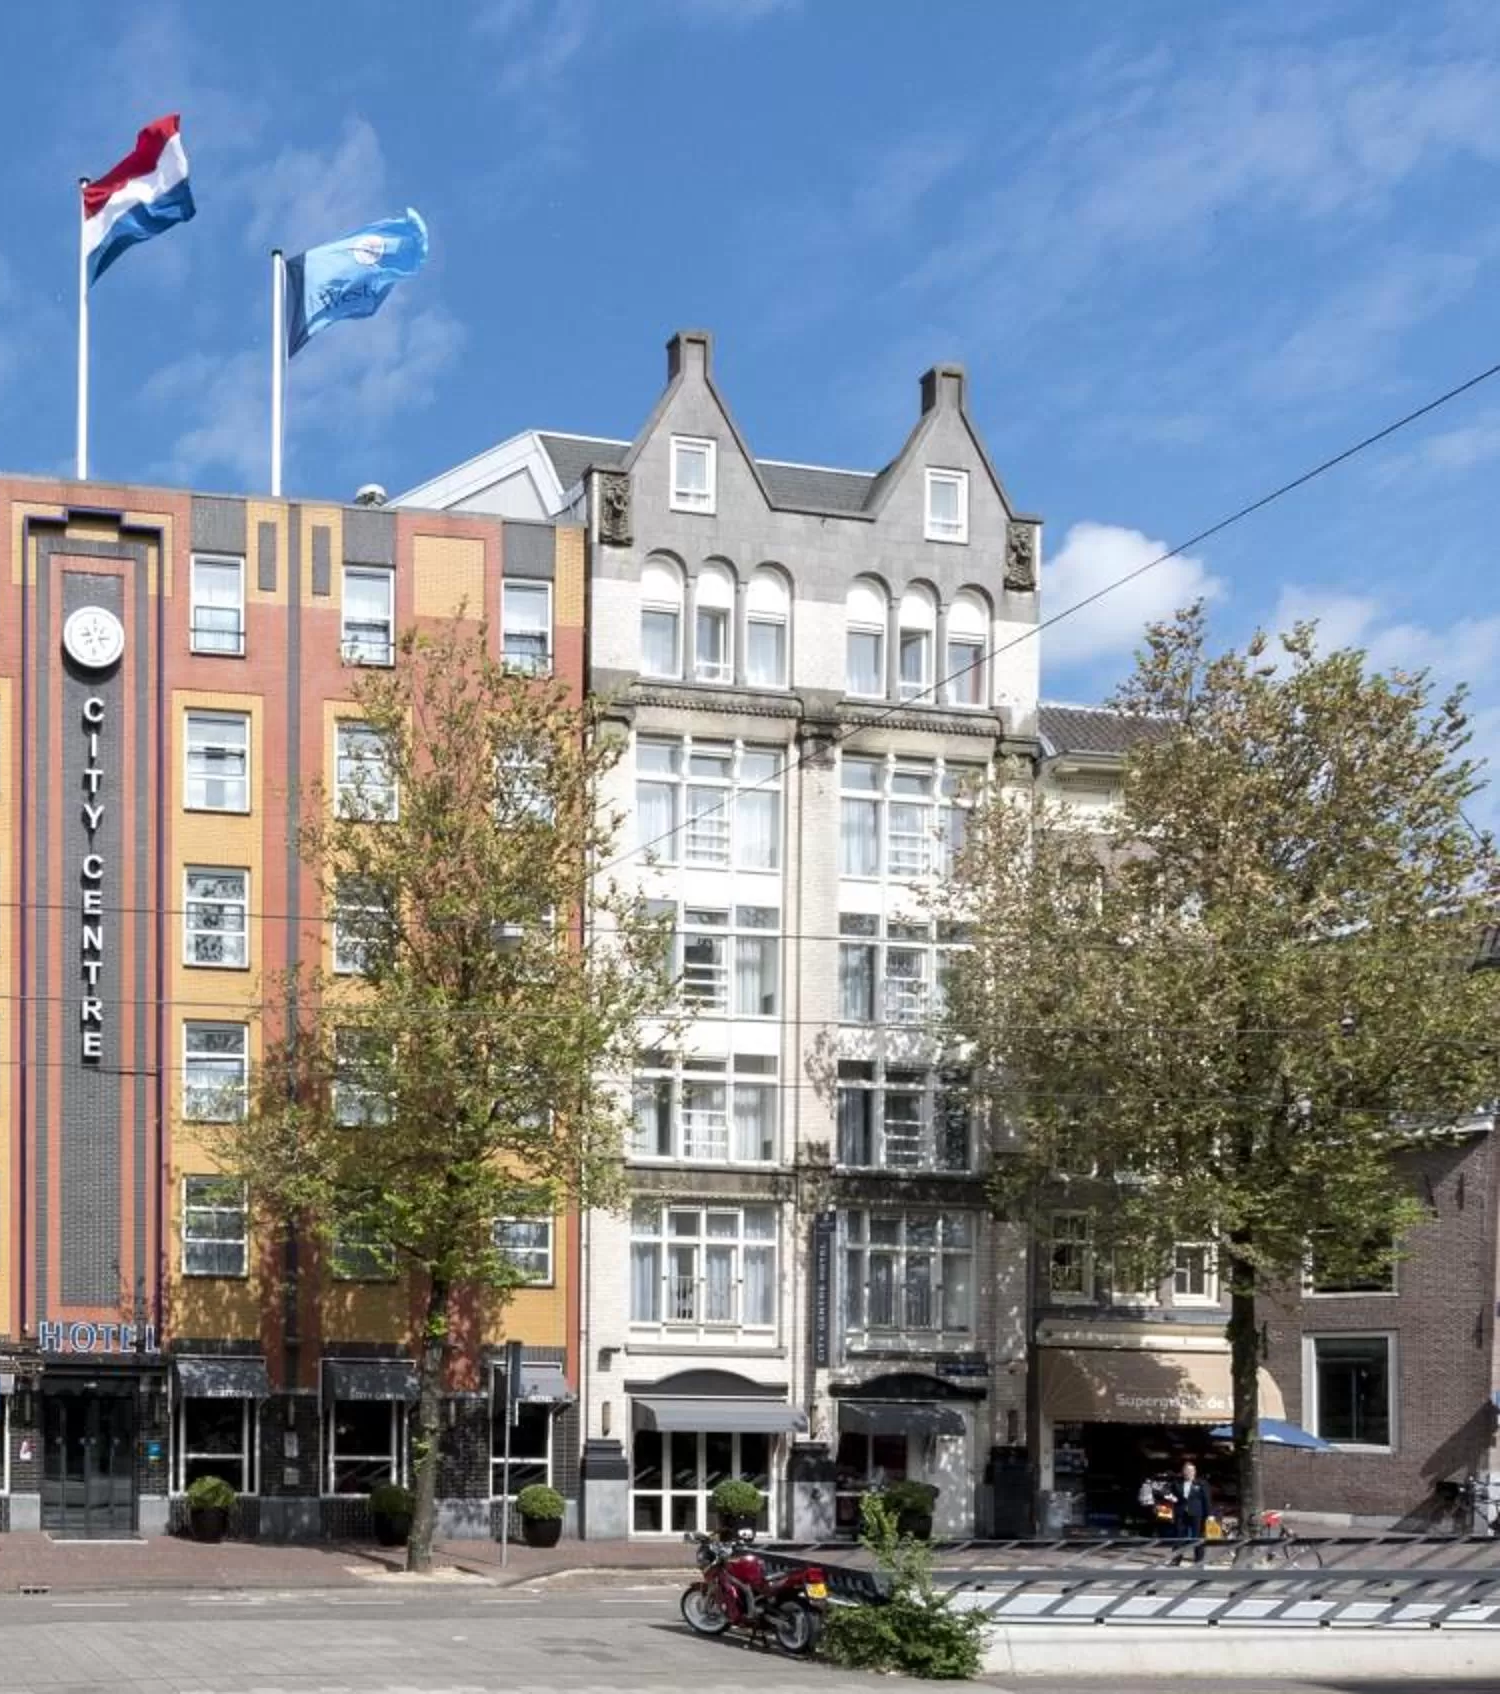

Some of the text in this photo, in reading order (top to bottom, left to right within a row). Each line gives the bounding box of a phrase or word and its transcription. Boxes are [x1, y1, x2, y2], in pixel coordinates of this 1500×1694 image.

[82, 698, 105, 1057] CITY CENTRE
[39, 1320, 161, 1353] HOTEL
